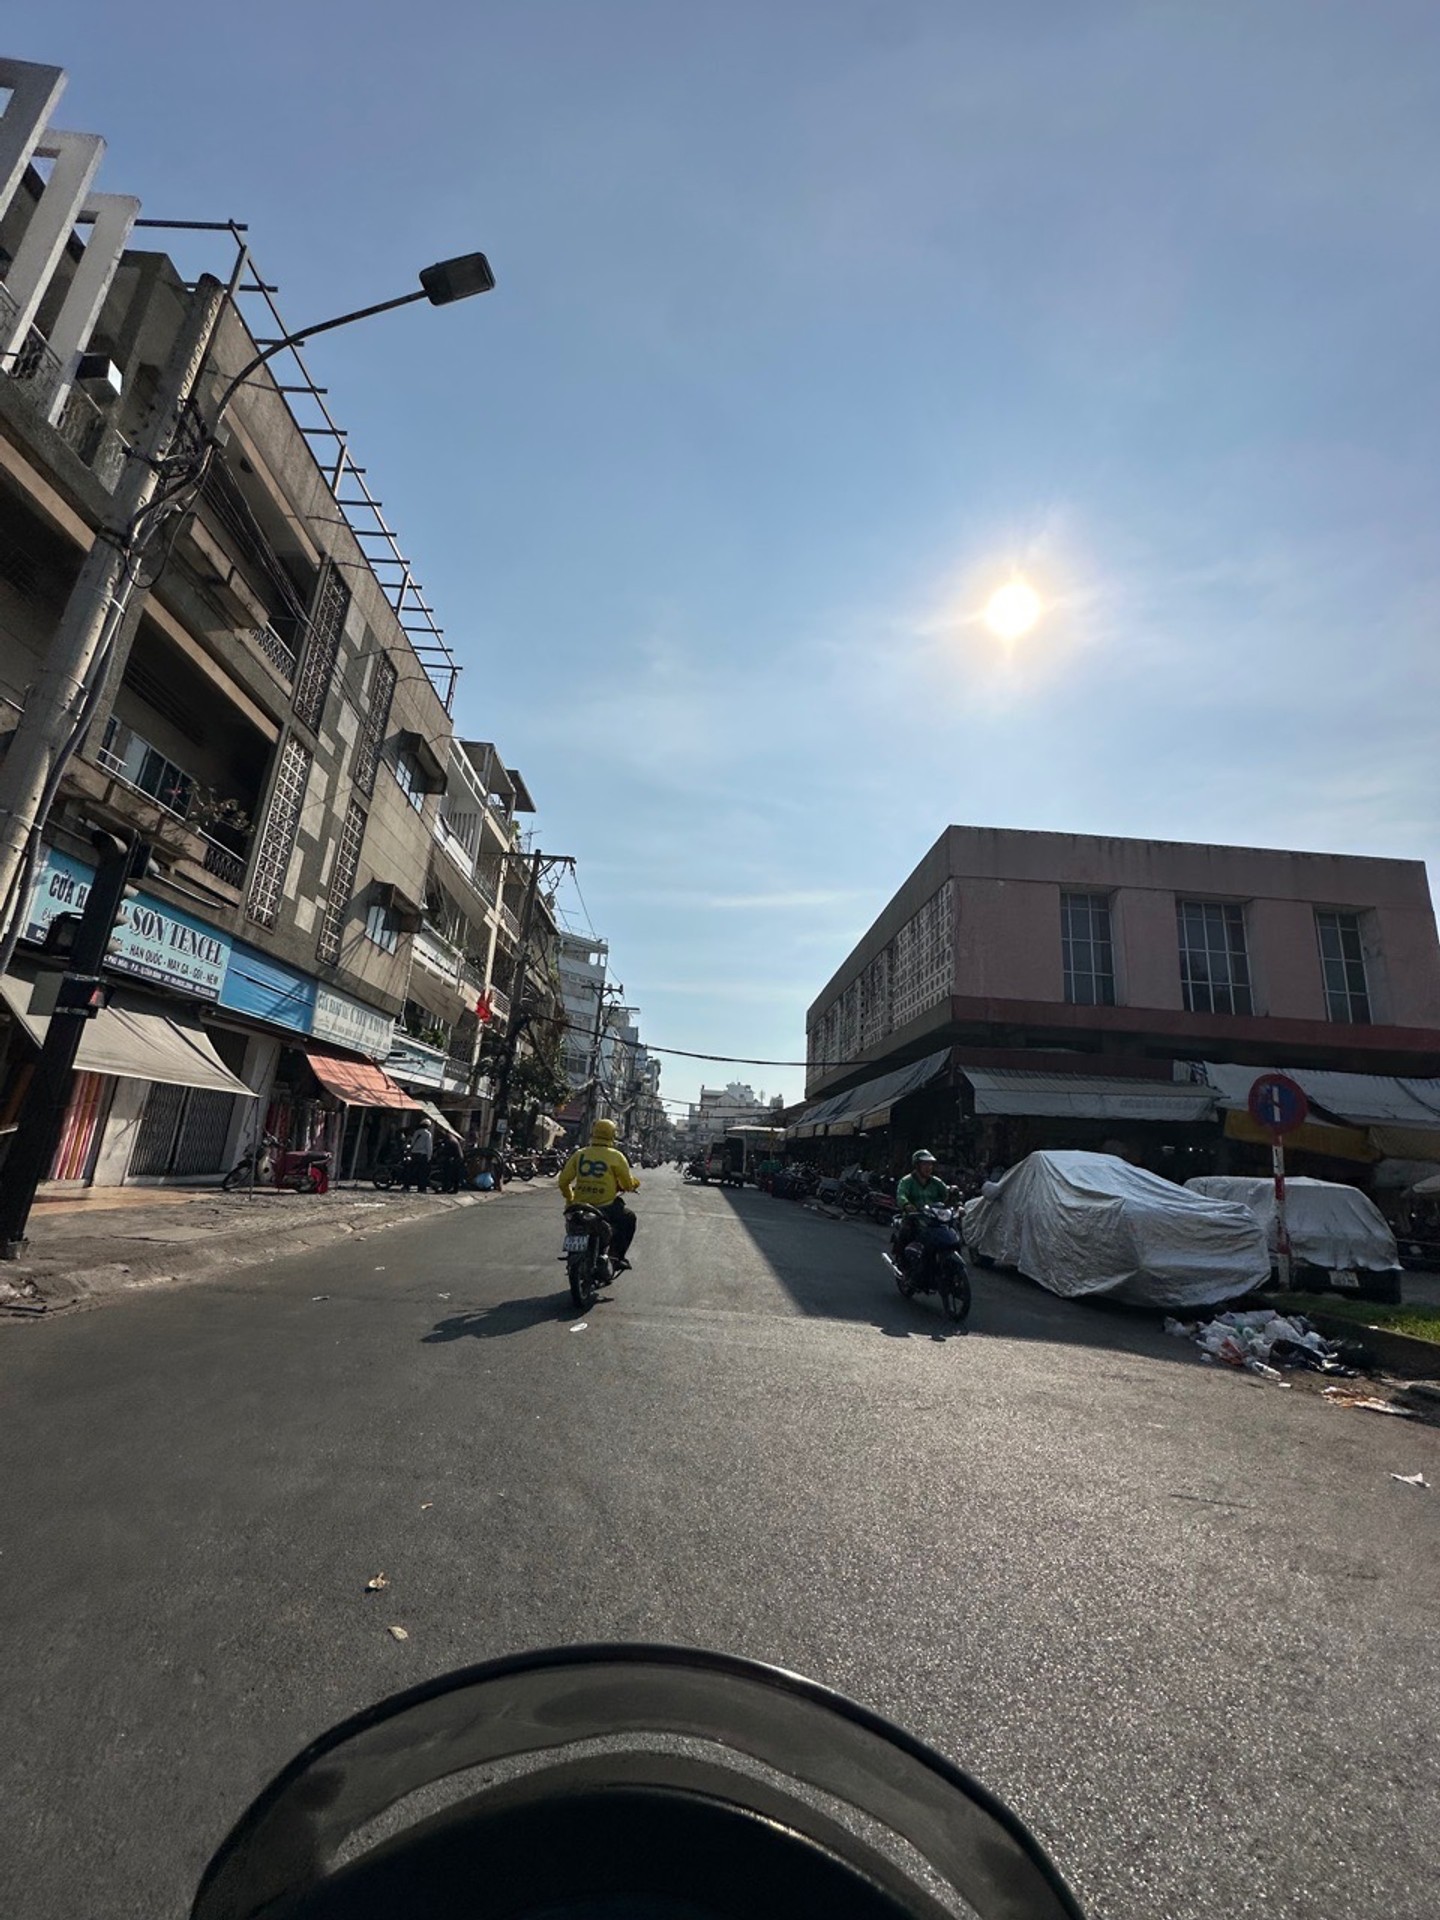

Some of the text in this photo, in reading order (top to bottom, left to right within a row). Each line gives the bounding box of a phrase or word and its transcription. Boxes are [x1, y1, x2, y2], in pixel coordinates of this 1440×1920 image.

[50, 870, 74, 904] CỬA
[129, 905, 167, 944] SƠN
[170, 923, 222, 967] TENCEL
[579, 1154, 608, 1178] be
